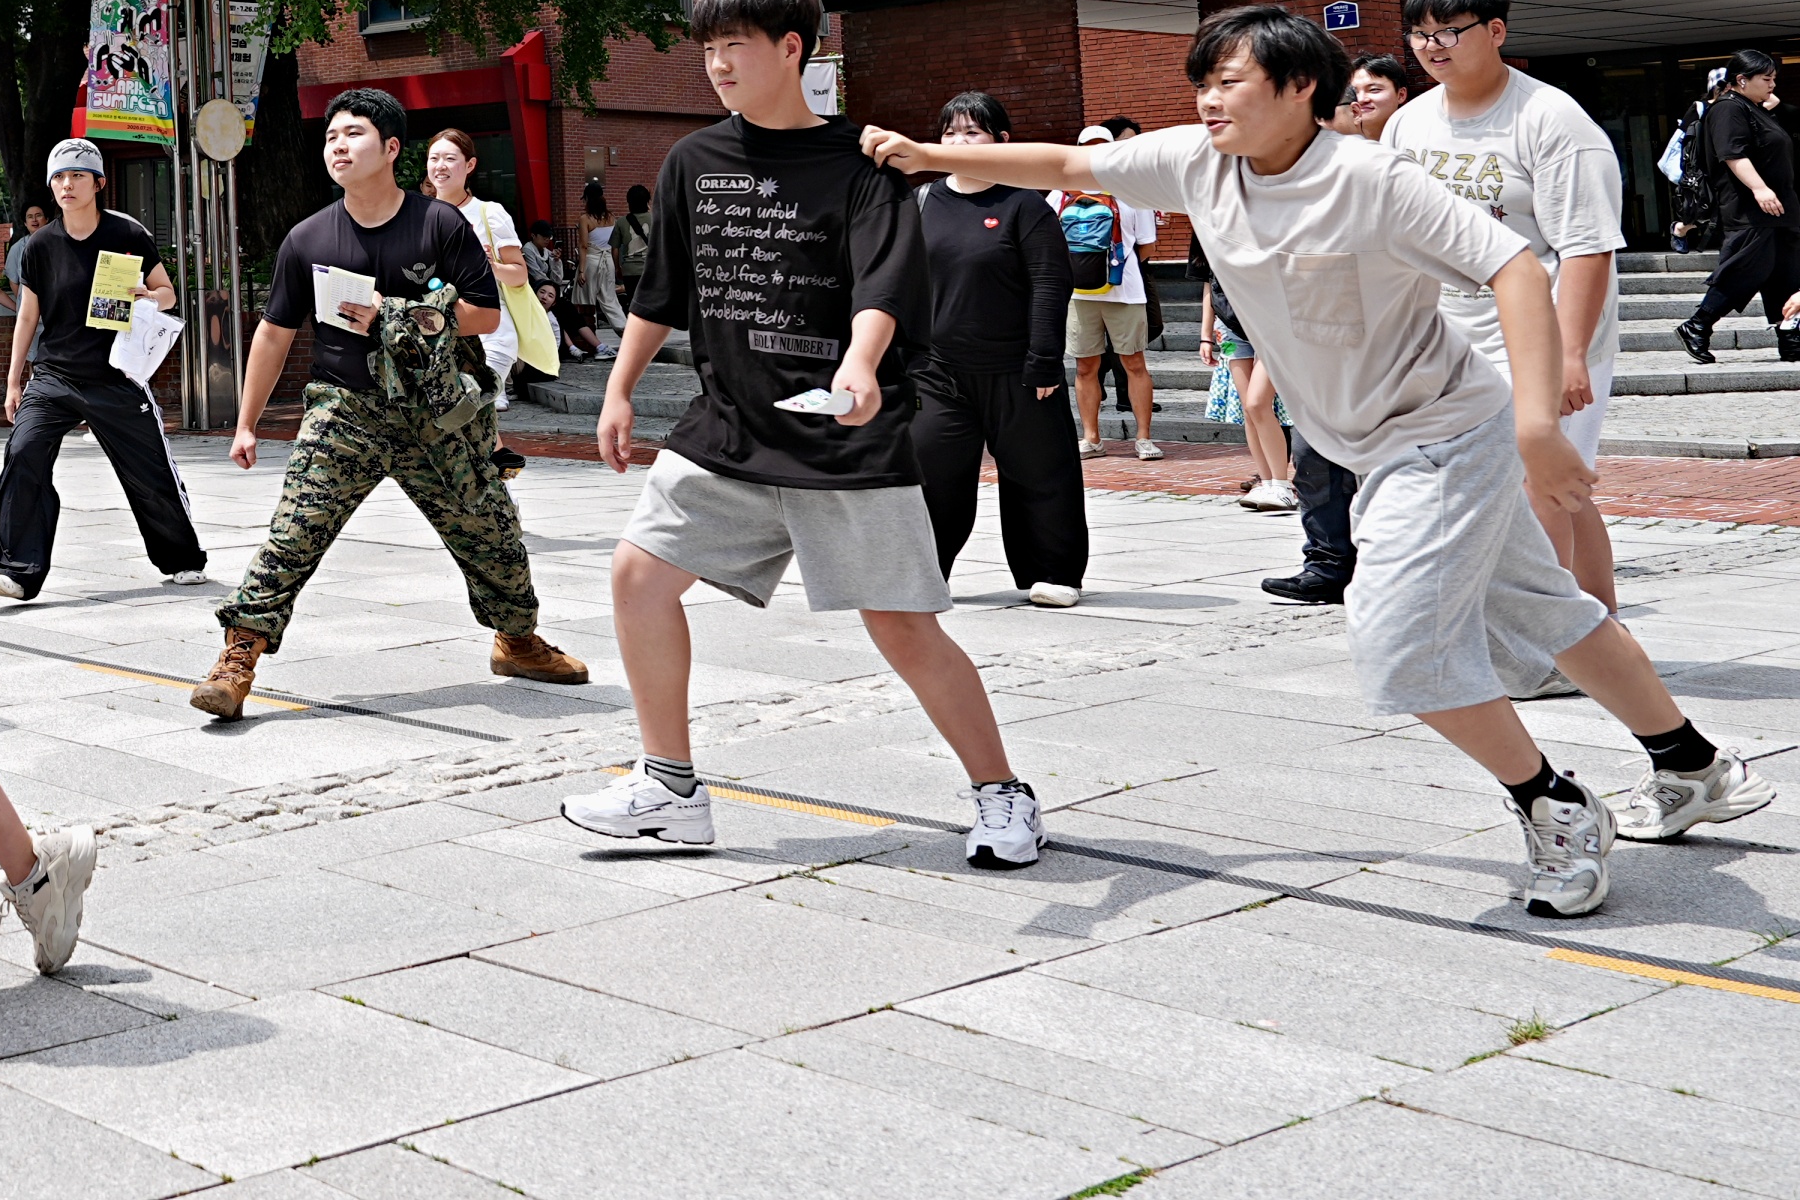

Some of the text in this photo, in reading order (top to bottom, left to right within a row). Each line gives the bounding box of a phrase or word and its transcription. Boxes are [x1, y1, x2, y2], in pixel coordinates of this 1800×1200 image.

[1337, 14, 1345, 25] 7
[93, 92, 127, 110] SUM
[700, 179, 750, 189] DREAM
[696, 198, 799, 220] We can unfold
[695, 221, 828, 243] our desired dreams
[724, 243, 750, 257] out
[750, 246, 783, 262] fear.
[715, 265, 737, 282] feel
[739, 263, 769, 286] free
[771, 269, 785, 285] to
[788, 274, 841, 290] pursue
[698, 284, 767, 303] your dreams
[701, 303, 792, 329] wholeheartedly
[779, 337, 824, 356] NUMBER
[826, 343, 833, 356] 7
